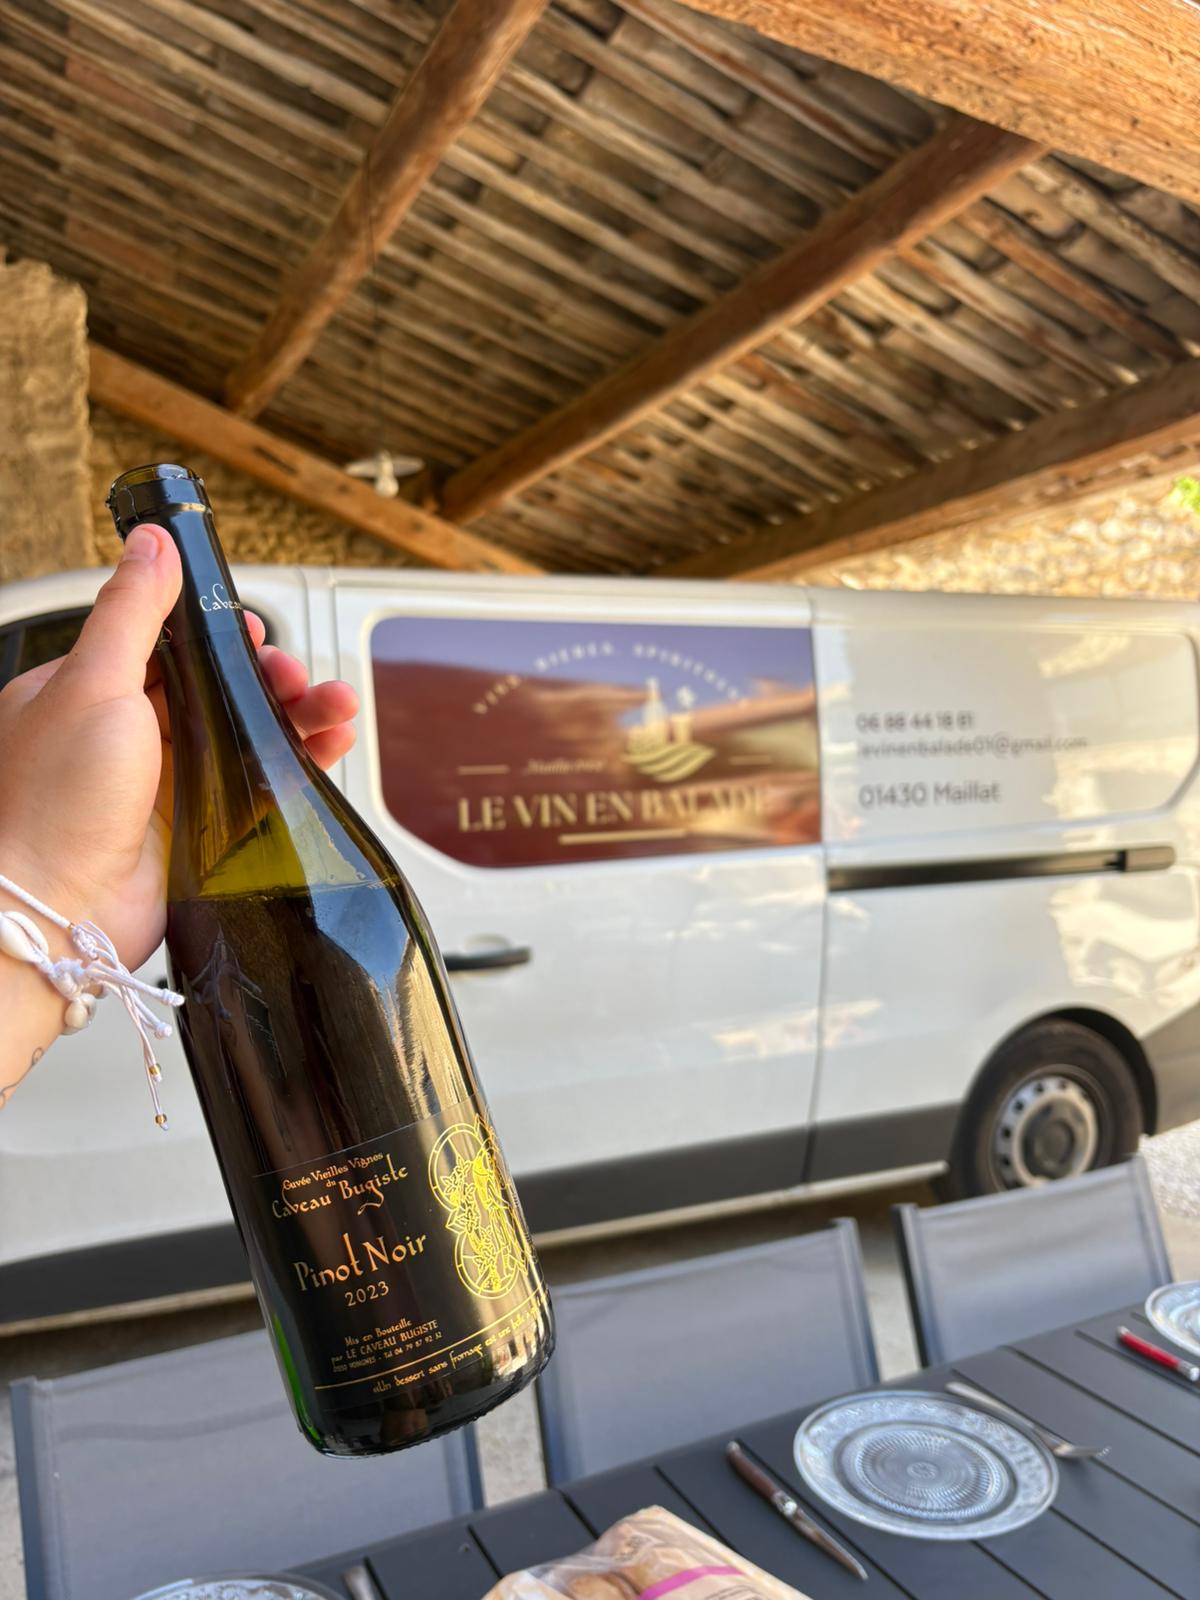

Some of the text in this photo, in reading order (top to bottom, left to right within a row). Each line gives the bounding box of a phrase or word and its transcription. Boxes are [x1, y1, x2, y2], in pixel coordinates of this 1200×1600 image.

[458, 796, 506, 832] LE
[513, 793, 577, 828] VIN
[585, 791, 634, 825] EN
[858, 781, 1002, 809] 01430 Maillat
[272, 1153, 409, 1218] Caveau Bugiste
[282, 1152, 384, 1191] Cuvée Vieilles Vignes
[326, 1179, 337, 1188] du
[293, 1232, 427, 1291] Pinot Noir
[345, 1280, 390, 1307] 2023
[344, 1317, 413, 1346] Mis en Bouteille
[345, 1348, 358, 1359] LE
[360, 1336, 397, 1355] CAVEAU
[400, 1319, 439, 1342] BUGISTE
[394, 1369, 425, 1387] dessert
[428, 1361, 449, 1374] sans
[449, 1343, 484, 1369] fromage
